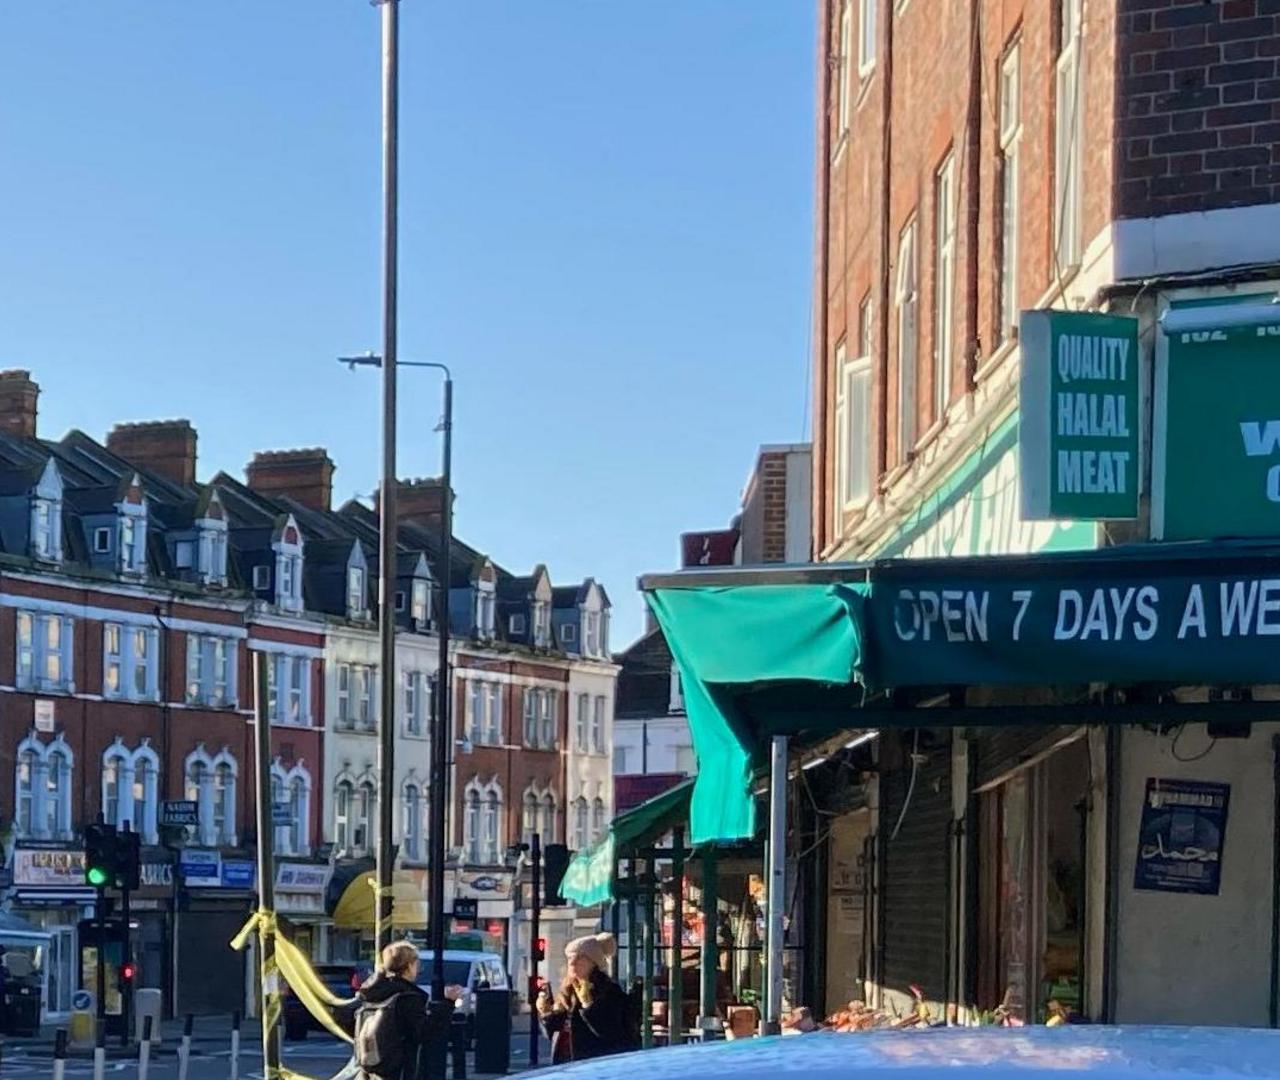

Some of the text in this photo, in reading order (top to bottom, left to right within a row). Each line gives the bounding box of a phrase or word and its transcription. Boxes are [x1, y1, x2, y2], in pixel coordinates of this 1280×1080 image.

[1058, 334, 1130, 383] QUALITY
[1058, 392, 1130, 437] HALAL
[1057, 450, 1130, 494] MEAT
[894, 589, 990, 643] OPEN
[1011, 590, 1033, 641] 7
[1053, 586, 1160, 641] DAYS
[1176, 583, 1208, 640] A
[139, 863, 174, 886] ABRICS
